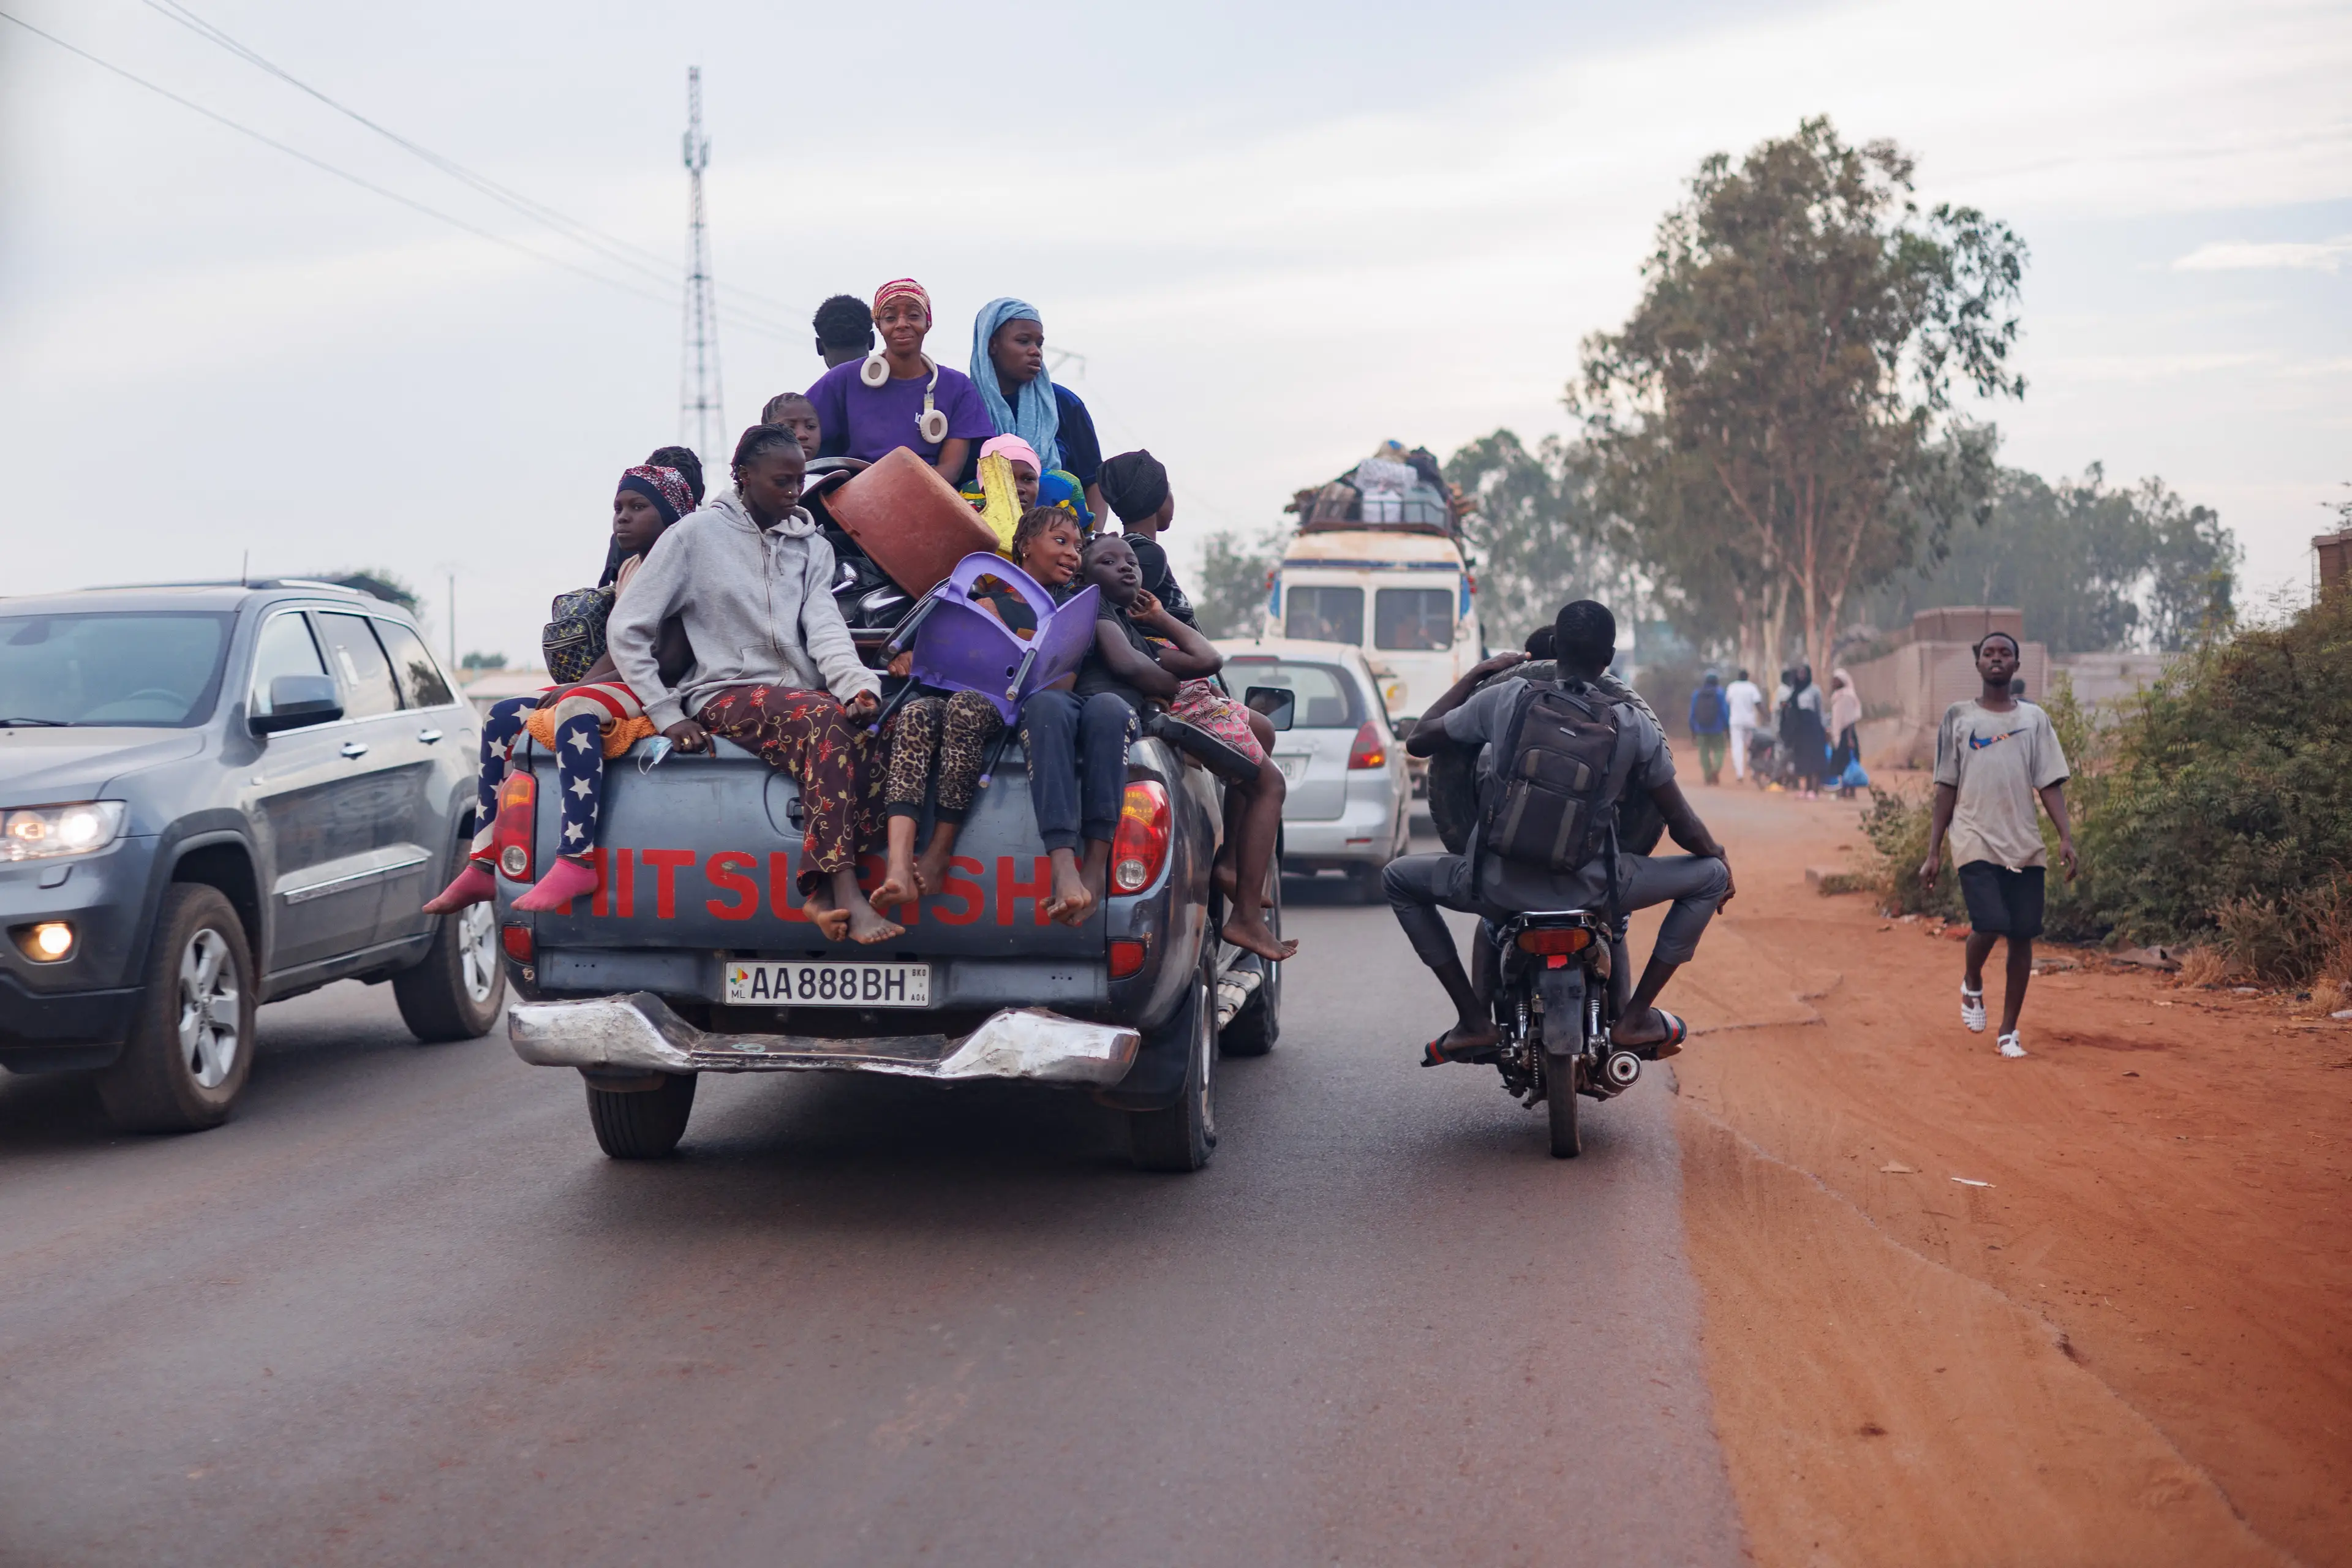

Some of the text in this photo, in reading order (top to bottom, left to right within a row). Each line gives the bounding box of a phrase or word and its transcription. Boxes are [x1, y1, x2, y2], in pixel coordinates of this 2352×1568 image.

[1123, 718, 1136, 766] BAND
[556, 848, 1083, 929] ITSUSH
[731, 990, 745, 999] ML
